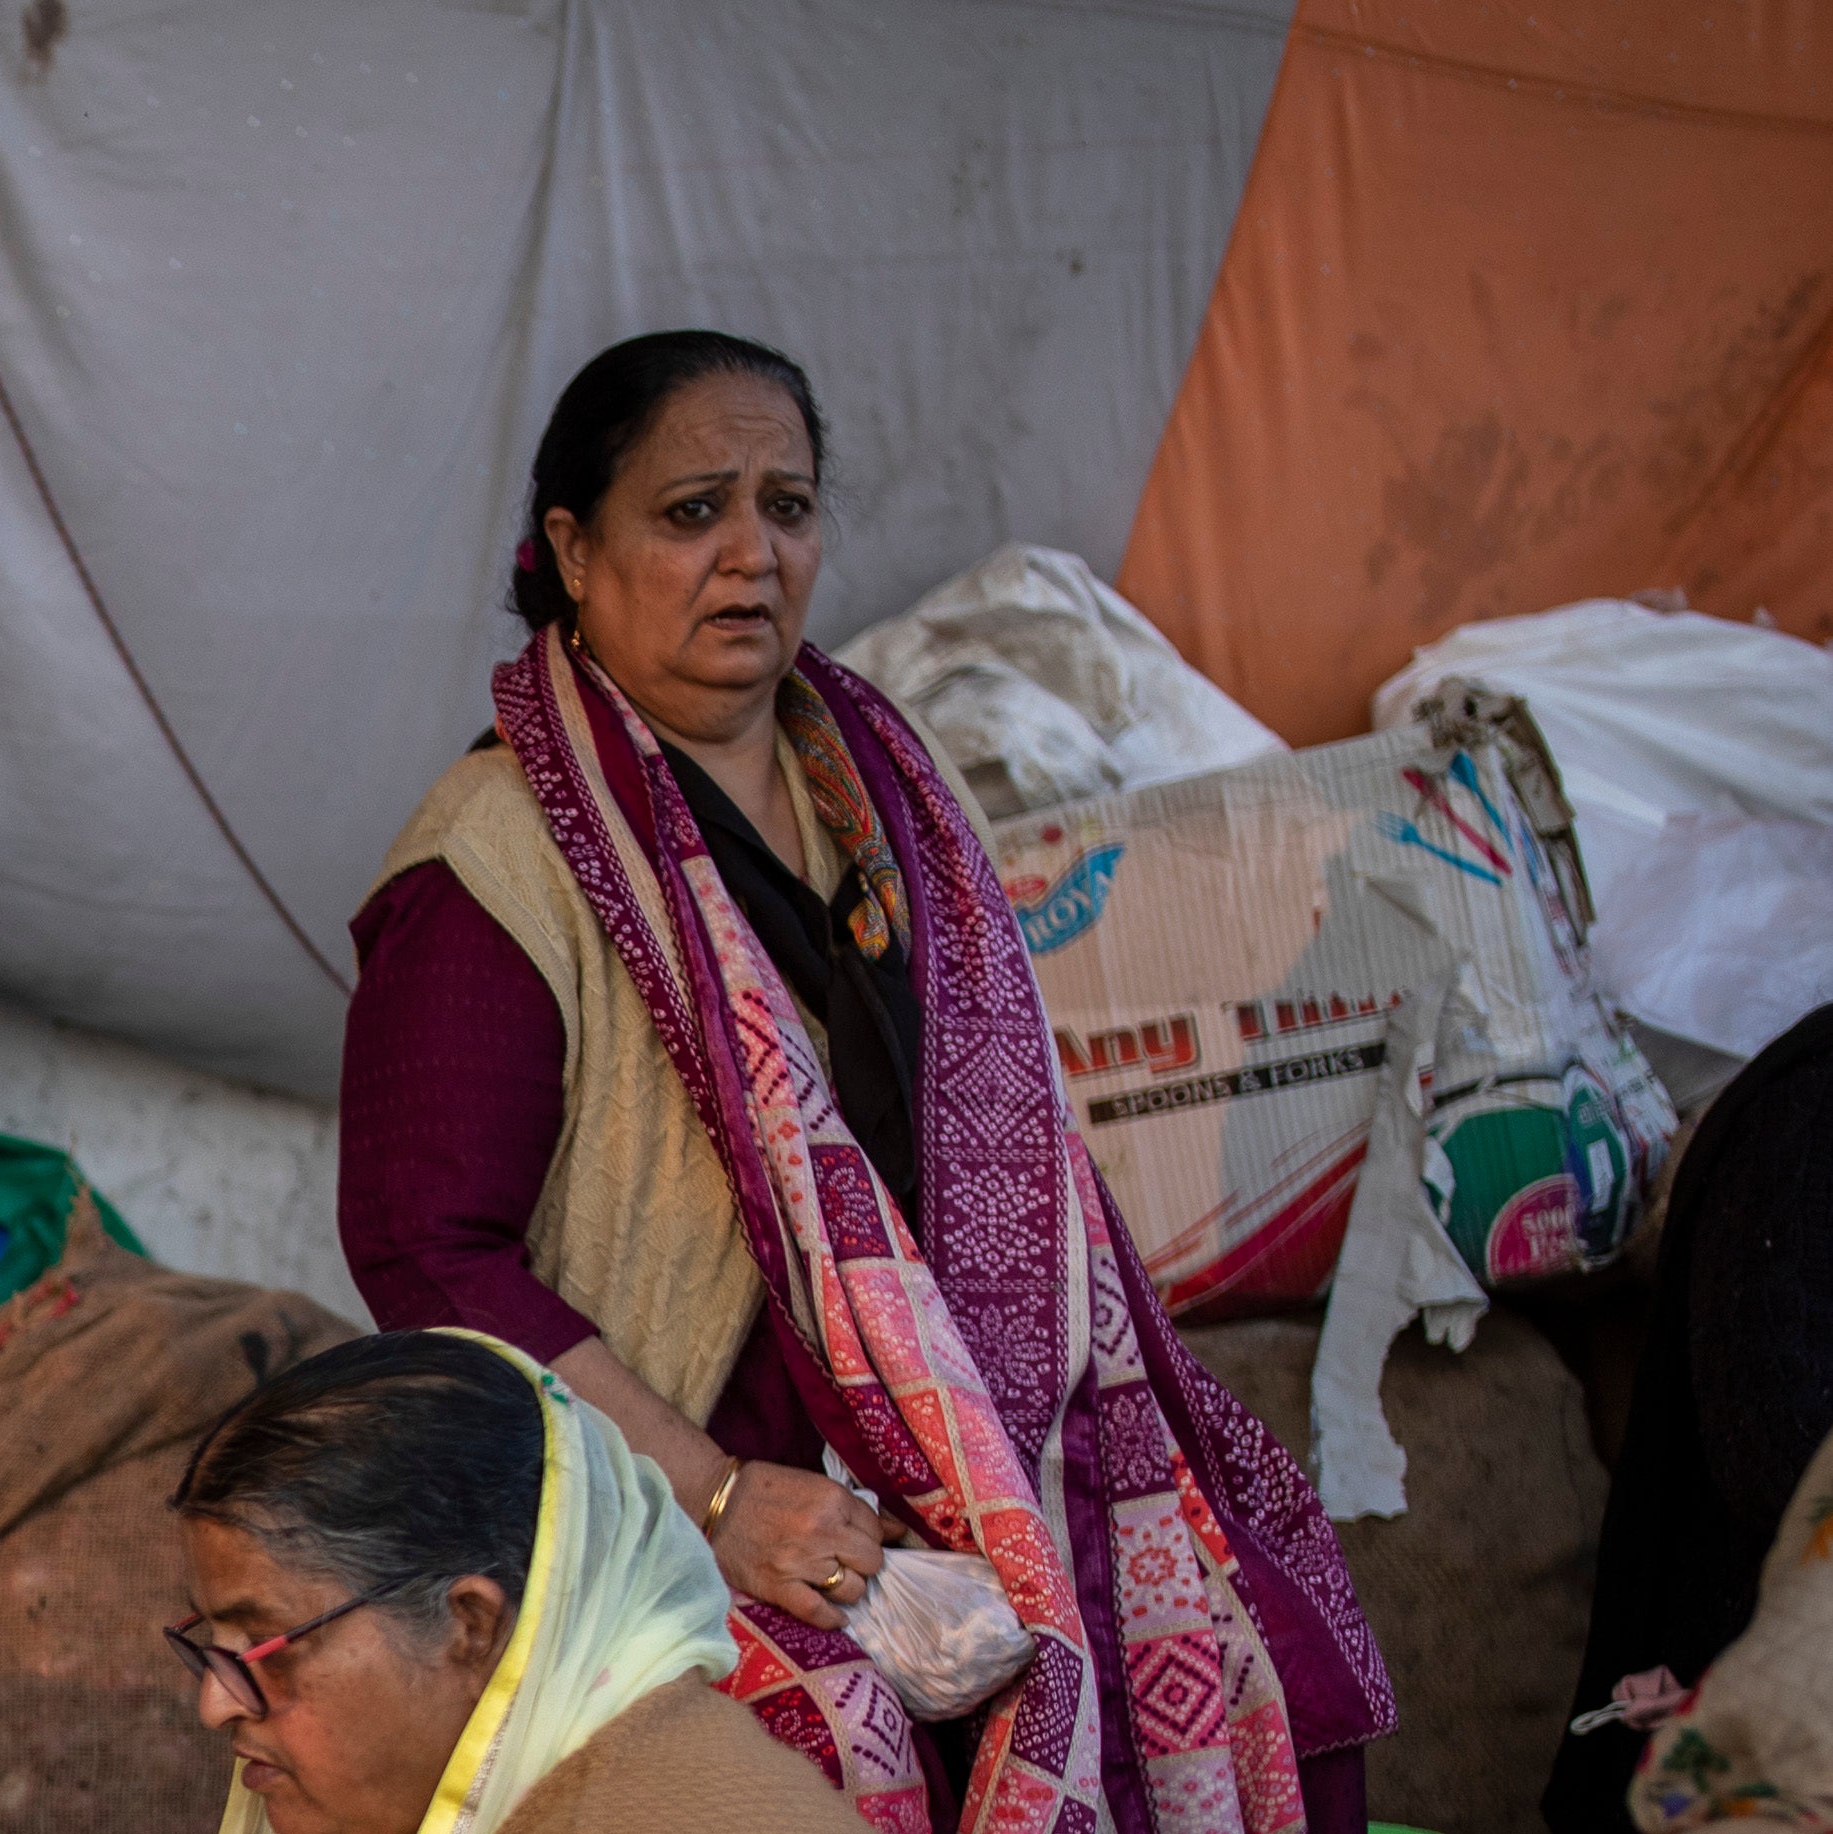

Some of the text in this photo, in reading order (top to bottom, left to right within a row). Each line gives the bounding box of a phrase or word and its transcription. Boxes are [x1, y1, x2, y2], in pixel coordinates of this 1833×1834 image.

[1053, 1011, 1197, 1078] Any
[1111, 1046, 1365, 1118] SPOONS & FORKS
